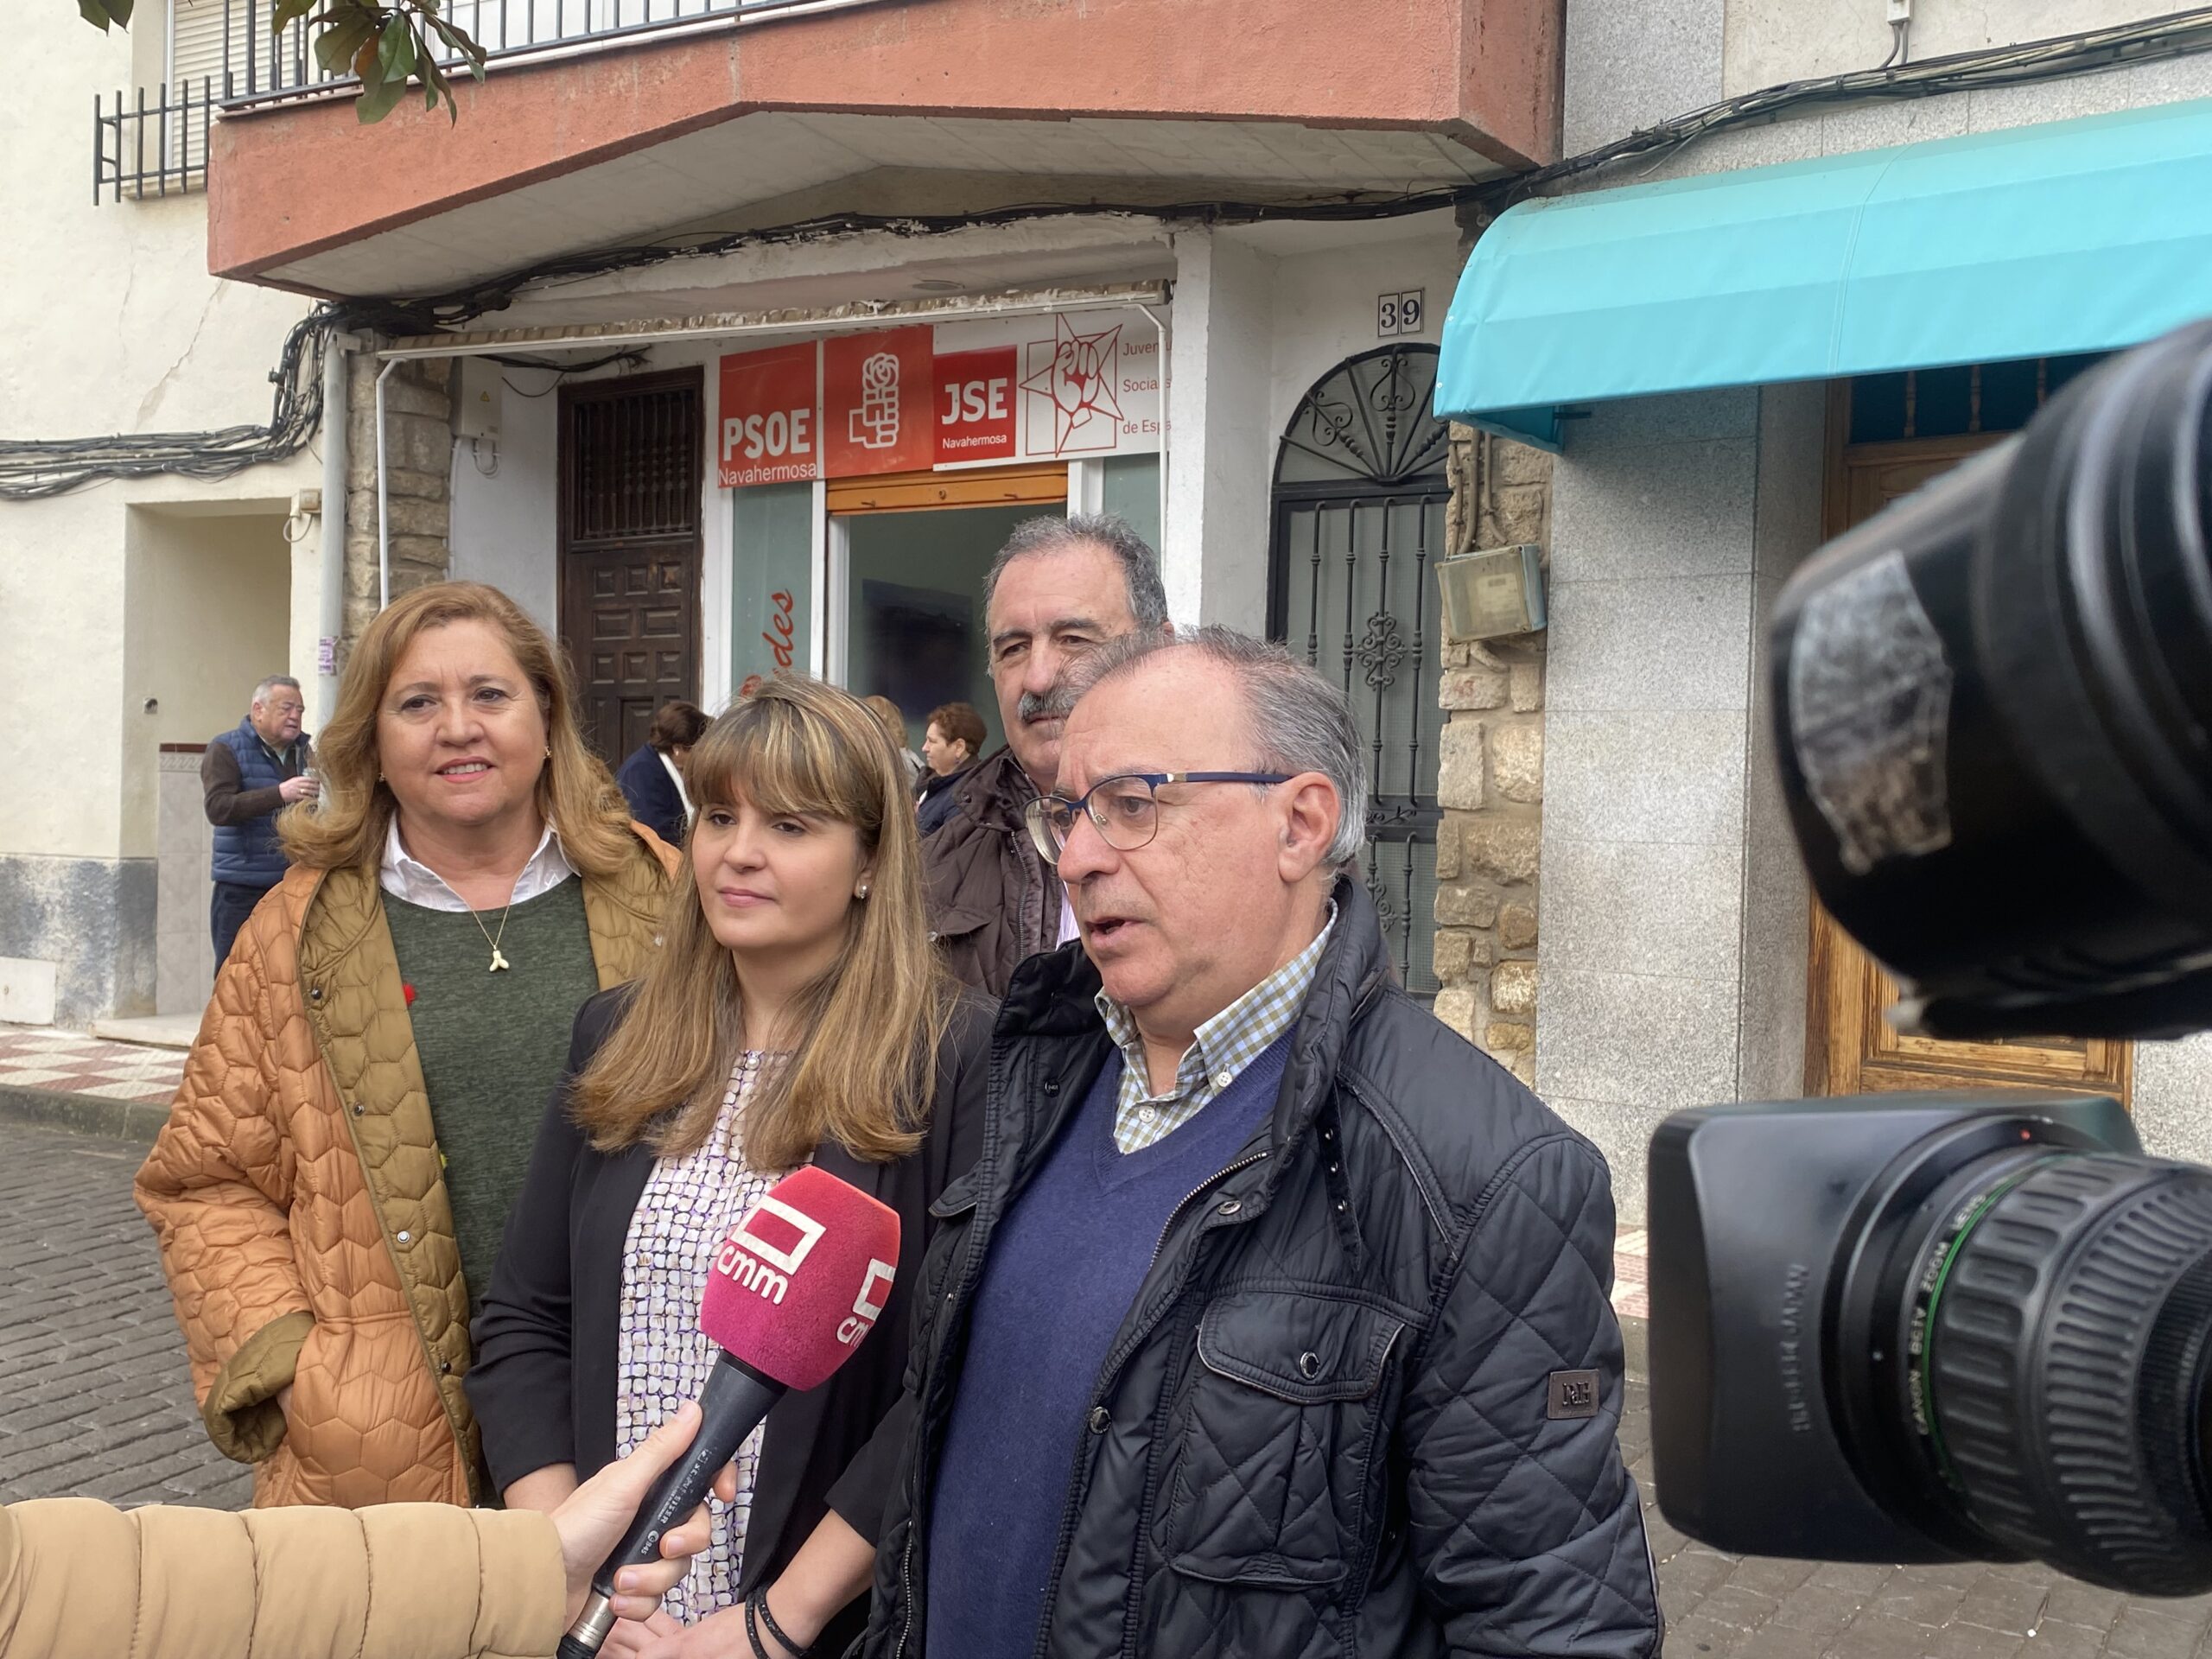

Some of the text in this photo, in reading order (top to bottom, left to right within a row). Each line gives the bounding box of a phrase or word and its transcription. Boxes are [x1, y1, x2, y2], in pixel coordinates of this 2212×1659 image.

[1381, 299, 1420, 328] 39
[941, 378, 1007, 425] JSE
[723, 408, 810, 461] PSOE
[942, 434, 1007, 449] Navahermosa
[1122, 421, 1139, 435] de
[718, 462, 817, 486] Navahermosa
[717, 1244, 789, 1306] cmm
[1920, 1242, 1950, 1293] ZOOM
